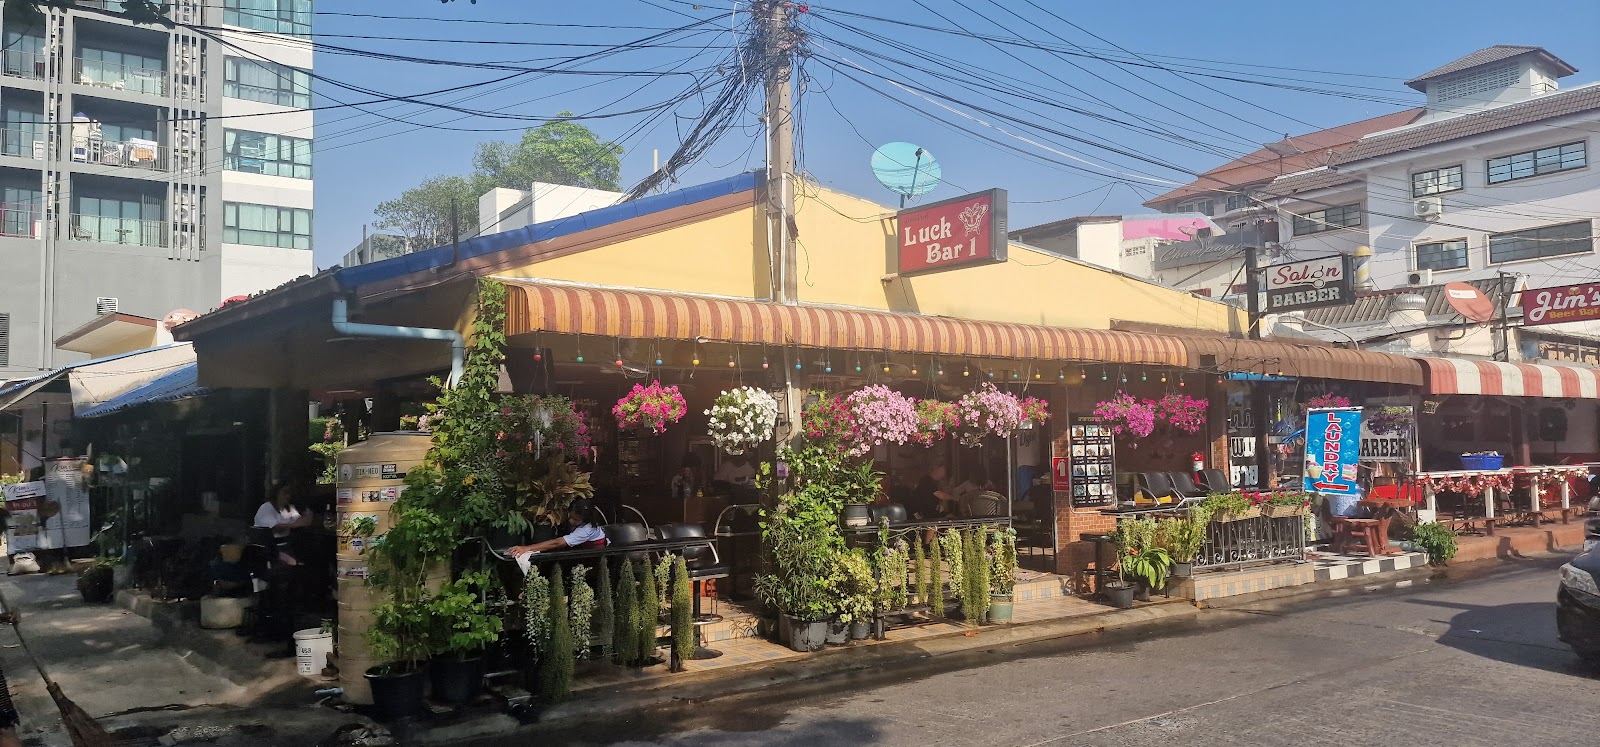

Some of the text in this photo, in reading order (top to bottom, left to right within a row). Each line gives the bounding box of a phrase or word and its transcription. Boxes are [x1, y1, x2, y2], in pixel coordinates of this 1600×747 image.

[904, 216, 953, 247] Luck
[925, 236, 977, 264] Bar 1
[1272, 287, 1340, 308] BARBER
[1529, 286, 1600, 322] Jim's
[1548, 307, 1599, 319] Beer Bar
[1323, 412, 1342, 483] LAUNDRY
[1358, 437, 1408, 458] ARBER
